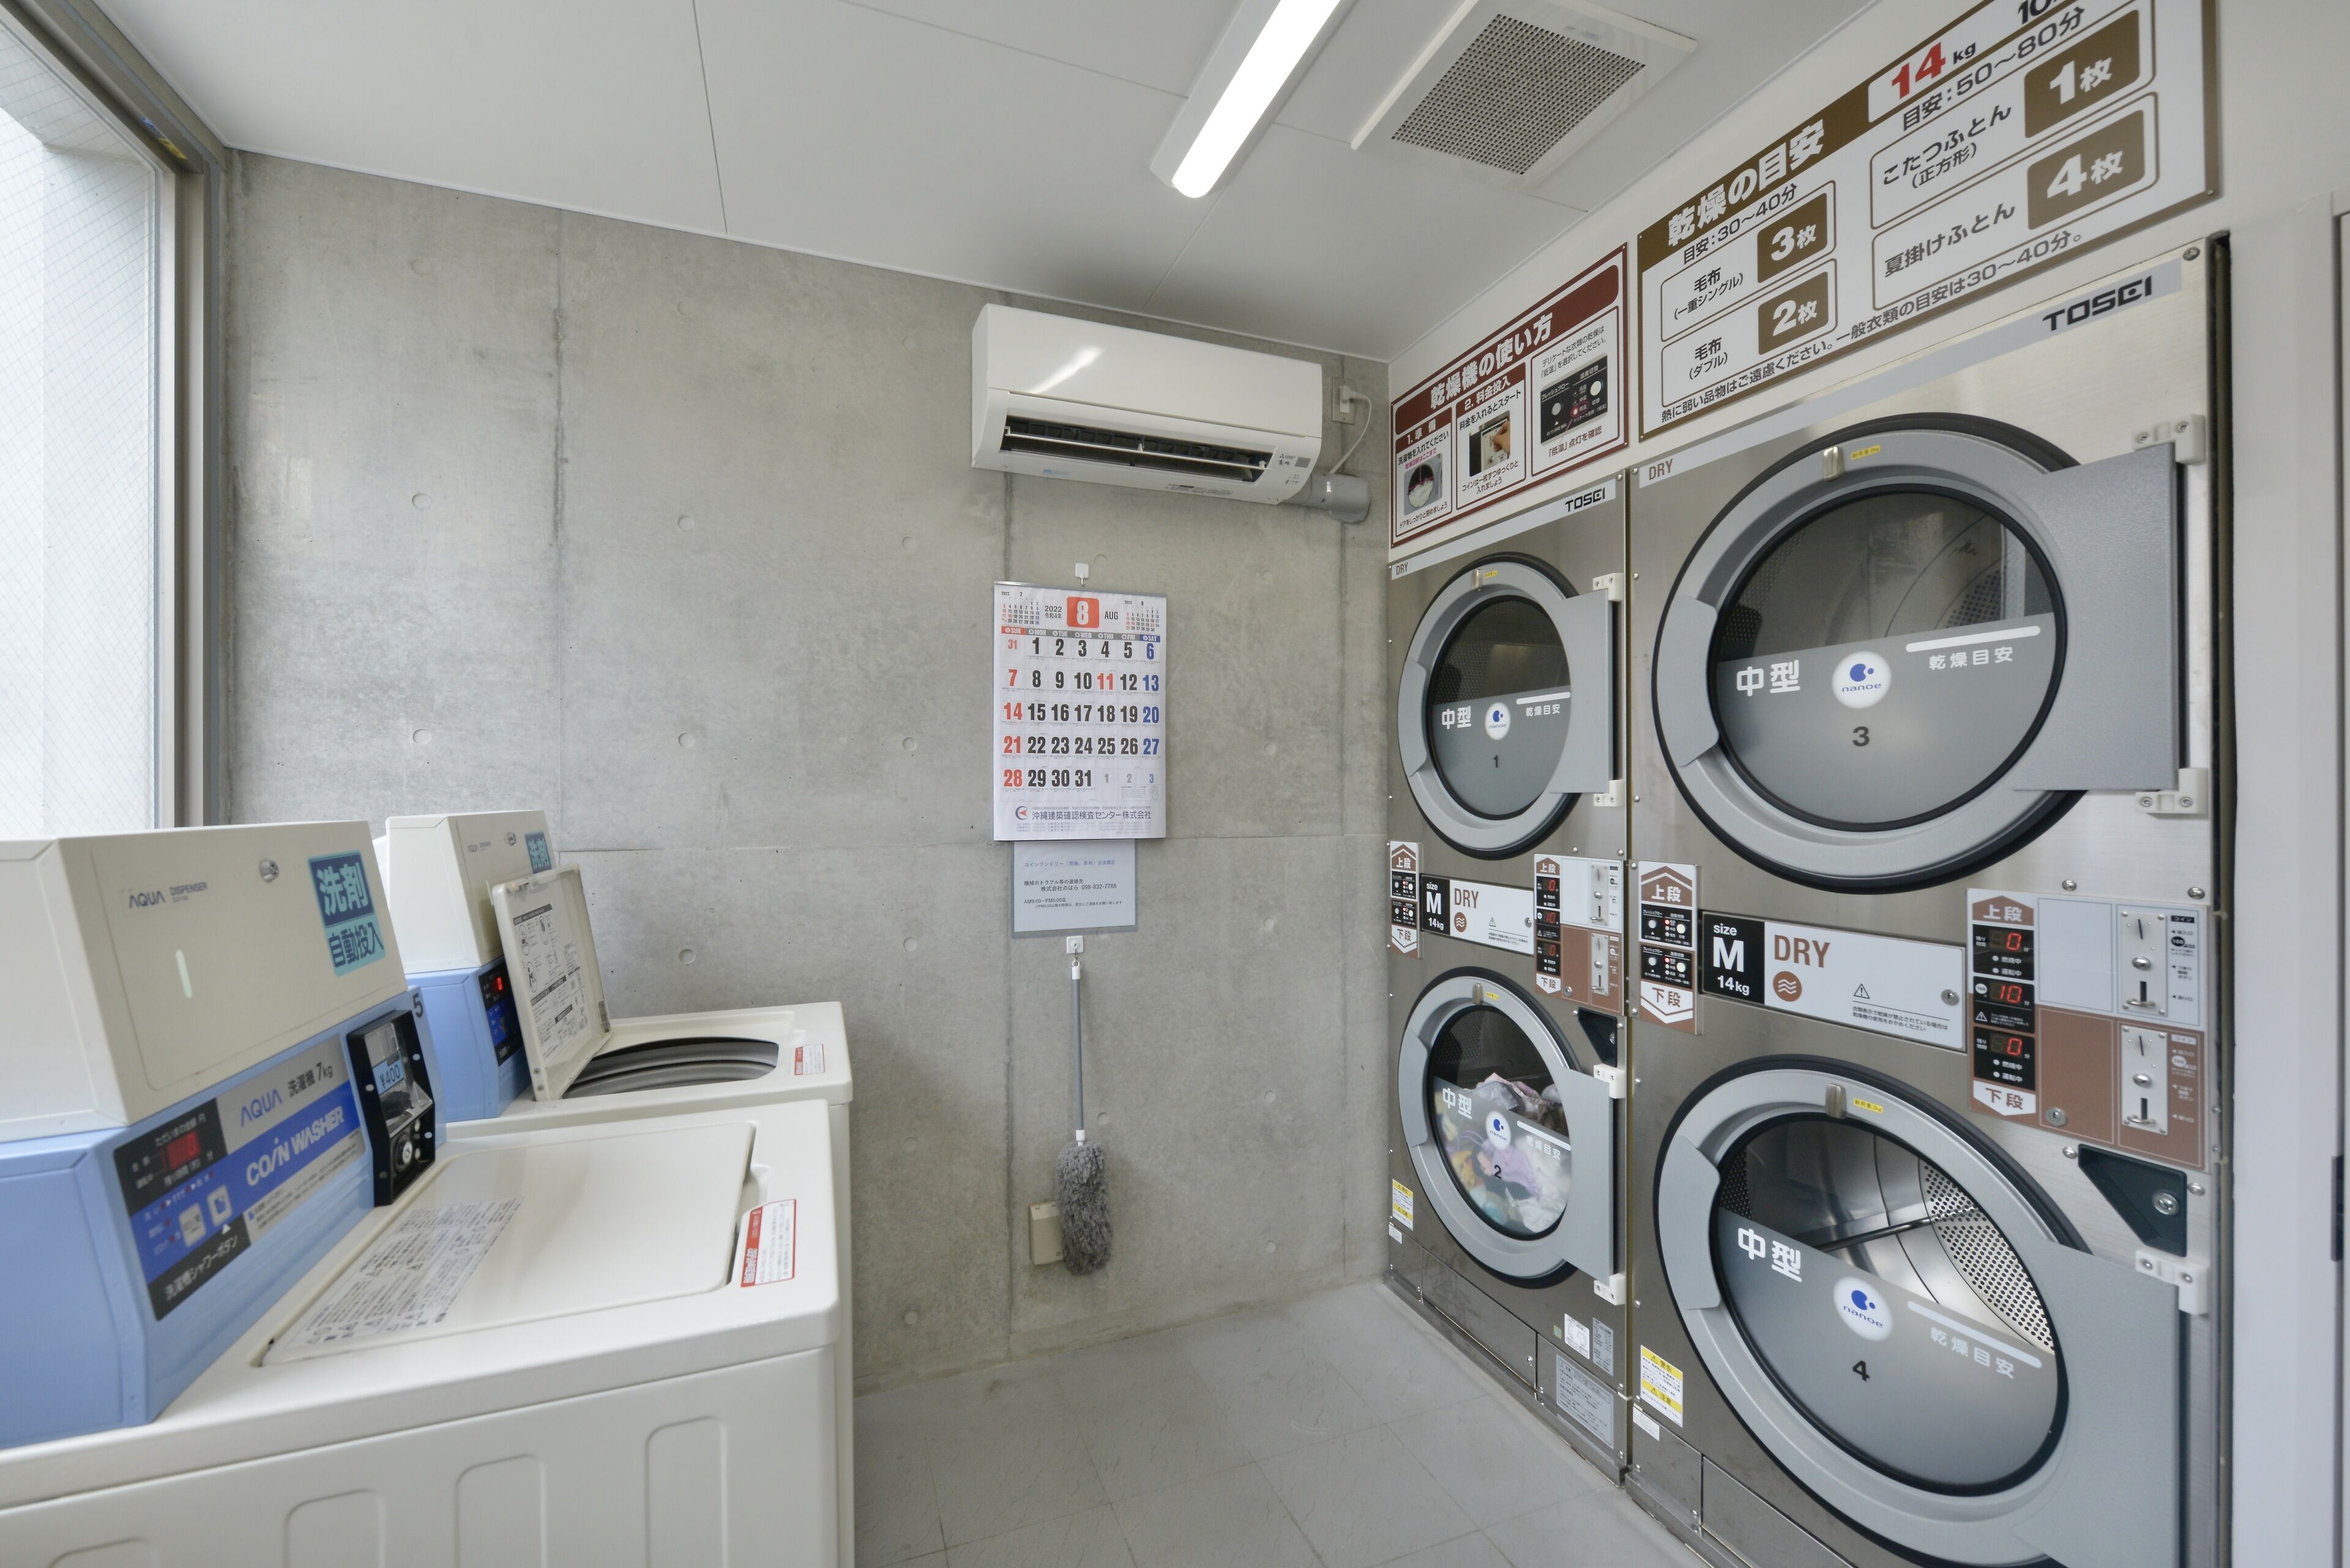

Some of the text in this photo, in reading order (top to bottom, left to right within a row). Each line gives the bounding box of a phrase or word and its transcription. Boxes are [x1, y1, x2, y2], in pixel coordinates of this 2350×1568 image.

[1891, 42, 1976, 99] 14 kg
[2050, 57, 2112, 105] 1枚
[1884, 105, 2012, 185] こたつふとん
[1912, 142, 1977, 189] (正方形)
[2047, 151, 2124, 199] 4枚
[1668, 119, 1825, 246] 乾燥の目安
[1770, 223, 1817, 261] 3枚
[1885, 203, 2015, 278] 夏掛けふとん
[1694, 267, 1721, 293] 毛布
[1674, 272, 1744, 320] (一重シングル)
[2042, 275, 2152, 332] TOSEI
[1772, 299, 1818, 337] 2枚
[1542, 326, 1605, 367] デリケートな衣類の乾燥は
[1695, 337, 1721, 360] 毛布
[1430, 312, 1553, 409] 乾燥機の使い方
[1689, 352, 1728, 381] (ダブル)
[1476, 375, 1510, 404] 料金投入
[1460, 389, 1521, 431] 料金を入れるとスタート
[1398, 430, 1449, 466] 洗濯物を入れてください
[1549, 425, 1602, 458] 「低温」点灯を確認
[1405, 447, 1437, 470] 乾燥目安はここまで
[1648, 459, 1674, 481] DRY
[1462, 460, 1519, 491] コインは一枚ずつゆっくりと
[1476, 477, 1502, 495] 入れましょう
[1565, 487, 1606, 512] TOSEI
[1400, 501, 1448, 529] ドアをしっかりと閉めましょう
[1396, 562, 1408, 576] DRY
[1077, 600, 1089, 625] 8
[1105, 611, 1119, 620] AUG
[1008, 637, 1154, 660] 31 1 2 3 4 5 6
[1928, 646, 2013, 671] 乾燥目安
[1009, 669, 1159, 691] 7 8 9 10 11 12 13
[1736, 659, 1801, 697] 中型
[1841, 681, 1882, 693] nanoe
[1004, 702, 1160, 723] 14 15 16 17 18 19 20
[1442, 706, 1472, 730] 中型
[1525, 703, 1561, 717] 乾燥目安
[1004, 736, 1160, 755] 21 22 23 24 25 26 27
[1852, 725, 1870, 748] 3
[1493, 755, 1499, 768] 1
[1004, 769, 1154, 787] 28 29 30 31 1 2 3
[1031, 810, 1151, 820] 沖縄建築確認検査センター株式会社
[1396, 857, 1411, 869] 上段
[1540, 863, 1556, 874] 上段
[129, 890, 166, 909] AQUA
[170, 882, 208, 896] DISPENSER
[316, 862, 368, 916] 洗剤
[1426, 881, 1439, 891] size
[1548, 879, 1556, 891] 0
[1651, 884, 1681, 902] 上段
[1426, 892, 1442, 915] M
[1454, 887, 1479, 909] DRY
[1428, 917, 1444, 931] 14kg
[1546, 912, 1556, 924] 10
[1983, 903, 2022, 922] 上段
[1397, 928, 1411, 942] 下段
[1713, 923, 1737, 936] size
[2006, 932, 2022, 950] 0
[328, 922, 384, 968] 自動投入
[1548, 944, 1556, 957] 0
[1713, 937, 1744, 973] M
[1774, 935, 1831, 968] DRY
[1541, 977, 1556, 989] 下段
[1717, 975, 1750, 996] 14kg
[2000, 985, 2022, 1004] 10
[412, 993, 423, 1018] 5
[1652, 987, 1681, 1007] 下段
[1852, 1012, 1926, 1031] 乾燥機の使用をおやめください
[2007, 1037, 2023, 1056] 0
[287, 1061, 334, 1097] 洗濯機 7kg
[379, 1064, 401, 1087] ¥400
[240, 1088, 283, 1127] AQUA
[1442, 1087, 1472, 1120] 中型
[1985, 1088, 2024, 1110] 下段
[246, 1137, 291, 1187] COIN
[291, 1105, 345, 1155] WASHER
[1490, 1130, 1507, 1142] nanoe
[1526, 1135, 1561, 1160] 乾燥目安
[1494, 1165, 1502, 1180] 2
[1737, 1226, 1802, 1282] 中型
[164, 1235, 238, 1301] 洗濯機シャワーボタン
[1843, 1304, 1884, 1329] nanoe
[1930, 1326, 2015, 1379] 乾燥目安
[1852, 1359, 1870, 1382] 4
